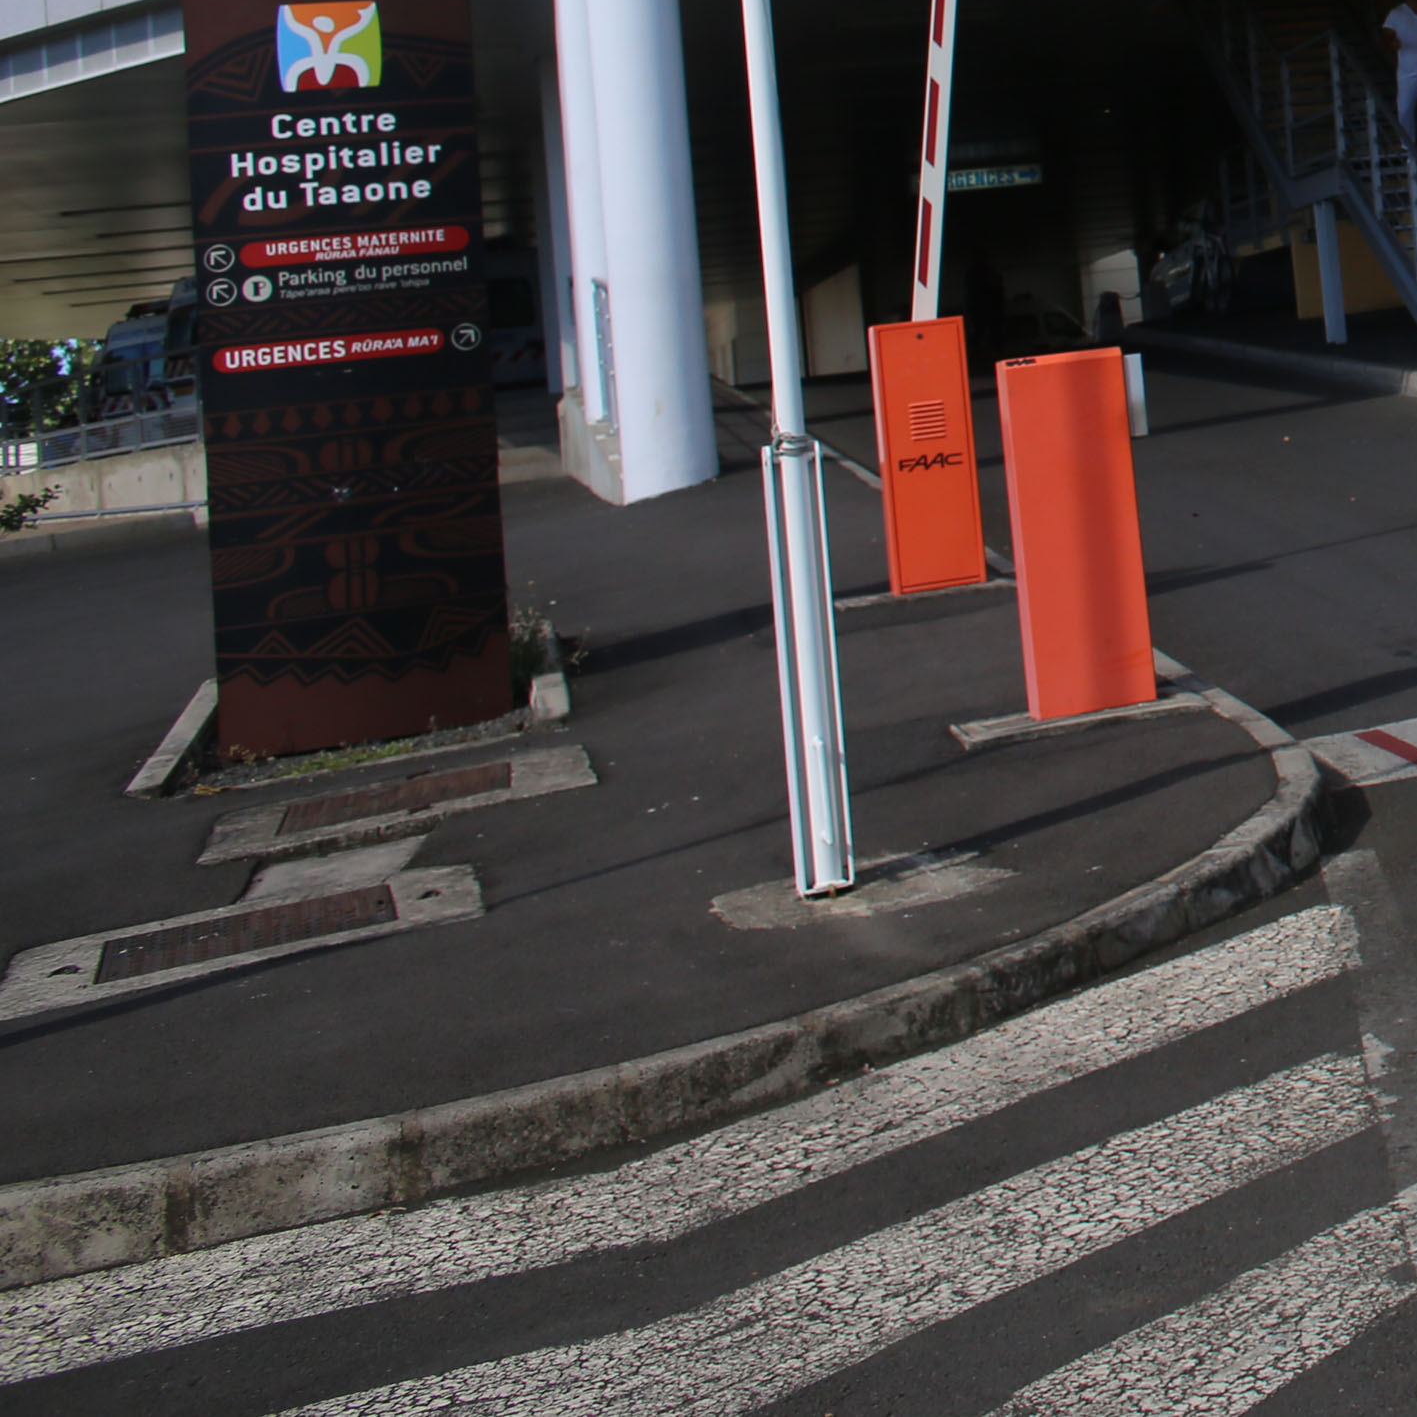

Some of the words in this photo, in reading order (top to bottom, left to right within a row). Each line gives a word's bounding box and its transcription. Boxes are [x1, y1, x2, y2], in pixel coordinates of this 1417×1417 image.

[271, 112, 396, 139] Centre
[230, 141, 442, 179] Hospitalier
[242, 187, 288, 211] du
[299, 179, 431, 206] Taaone
[266, 237, 352, 256] URGENCES
[278, 268, 346, 286] Parking
[355, 264, 376, 279] du
[382, 256, 467, 281] personnel
[225, 339, 346, 369] URGENCES
[899, 452, 963, 472] FAAC
